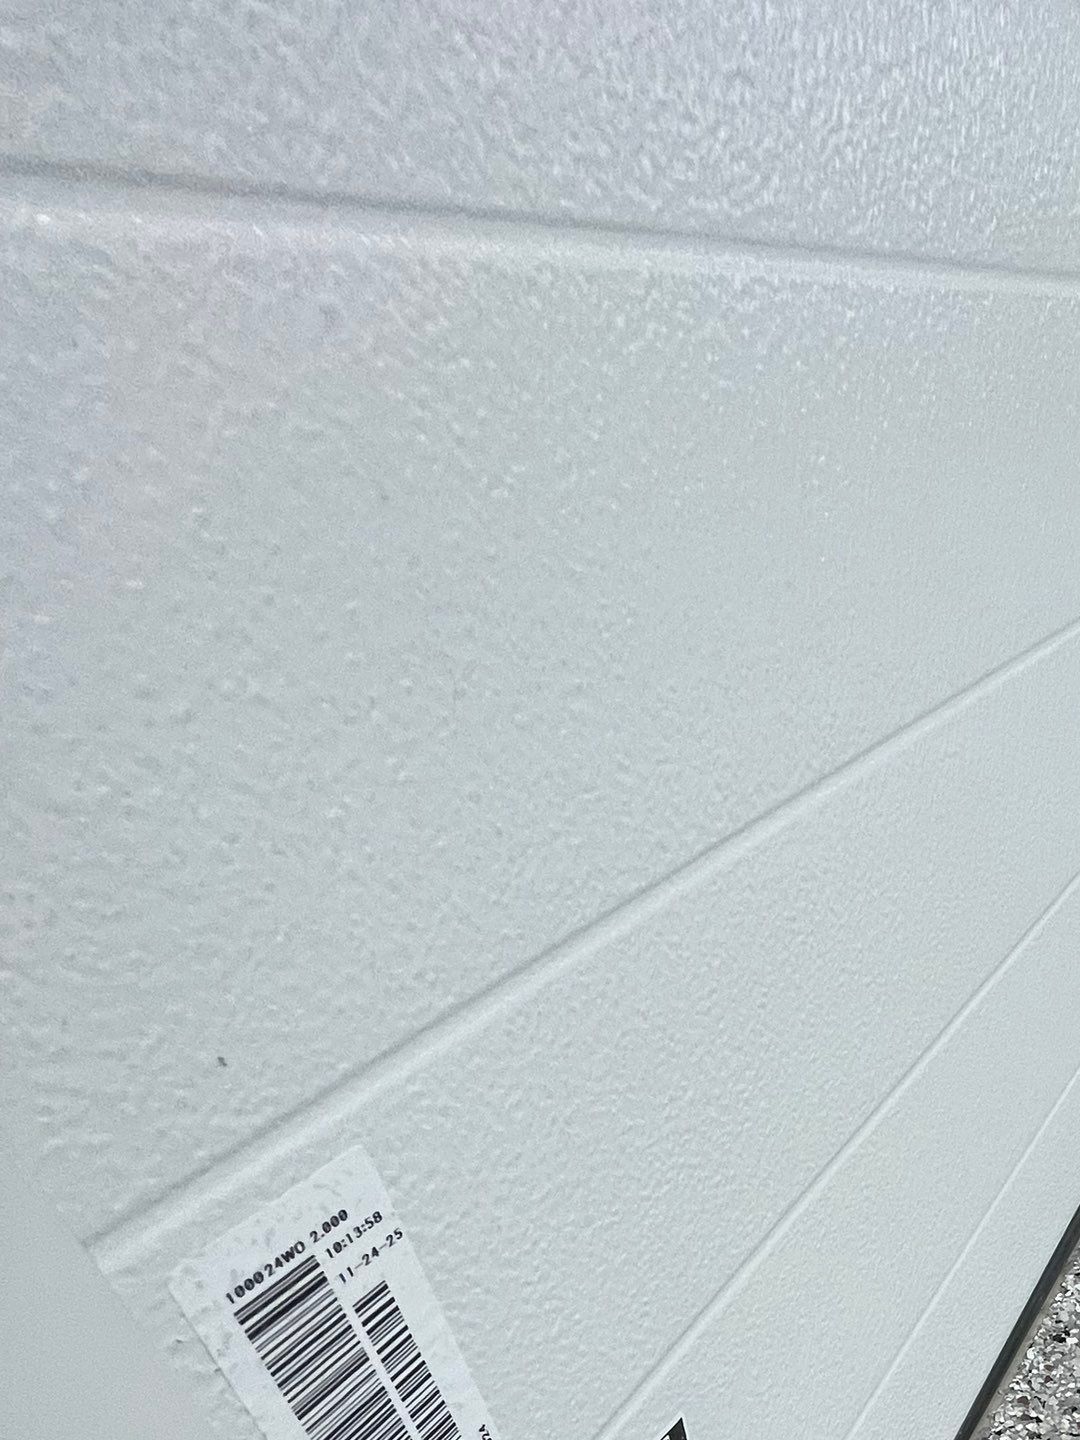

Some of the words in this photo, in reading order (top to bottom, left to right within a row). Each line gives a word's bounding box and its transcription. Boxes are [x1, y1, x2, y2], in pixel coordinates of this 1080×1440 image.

[309, 1209, 348, 1243] 2.000
[325, 1211, 382, 1258] 10:13:58
[338, 1228, 404, 1284] 11-24-25
